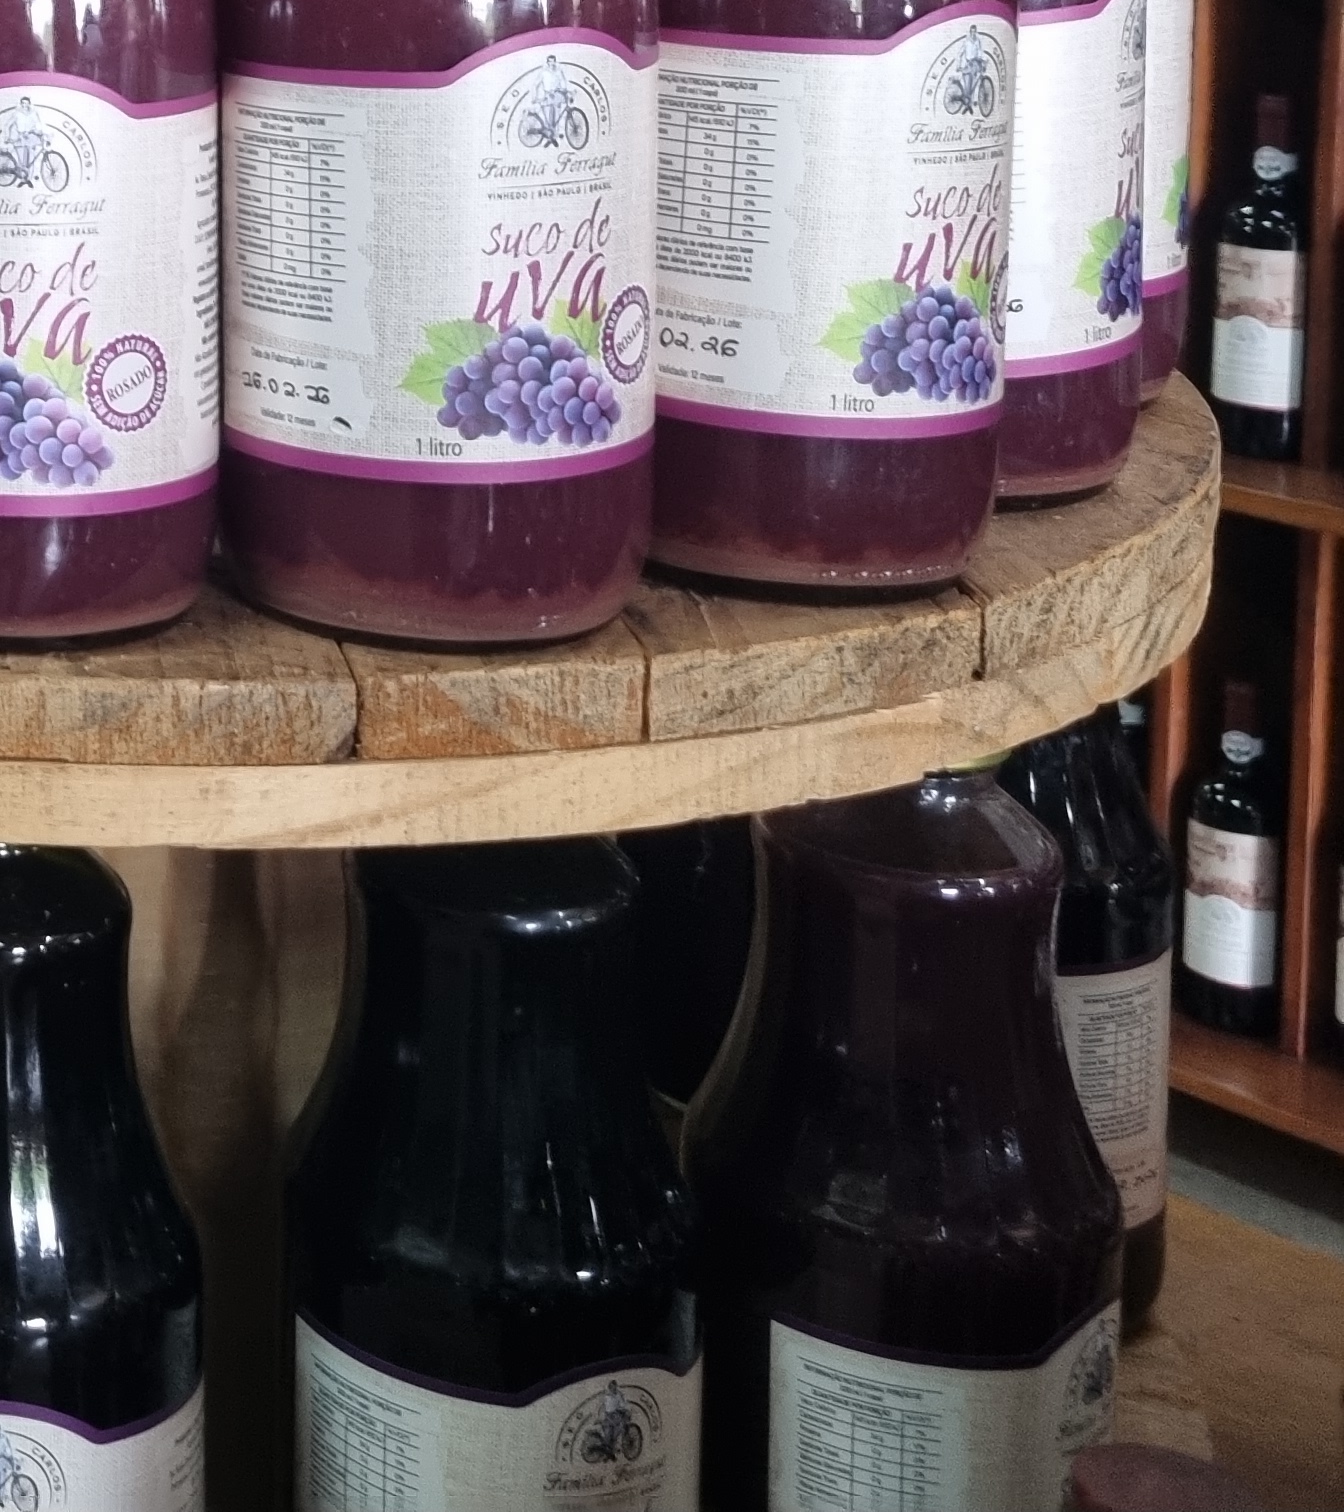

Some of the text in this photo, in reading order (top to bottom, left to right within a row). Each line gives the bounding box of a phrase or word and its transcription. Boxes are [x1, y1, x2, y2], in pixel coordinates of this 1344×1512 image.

[583, 76, 608, 123] CARLOS
[62, 120, 94, 169] CARLOS
[907, 122, 964, 144] Família
[478, 151, 617, 179] Família Ferragut
[28, 193, 107, 220] Ferragut
[487, 191, 528, 200] VINHEDO
[537, 188, 554, 199] SÃO
[556, 185, 582, 196] PAULO
[905, 162, 1002, 220] suco de
[10, 226, 28, 237] SÃO
[30, 228, 60, 237] PAULO
[481, 196, 611, 258] suco de
[49, 241, 100, 297] de
[893, 213, 998, 294] uva
[472, 250, 609, 334] uva
[91, 350, 115, 380] 100%
[115, 339, 159, 362] NATURAL
[105, 364, 152, 403] ROSADO
[842, 394, 875, 414] litro
[429, 437, 462, 456] litro
